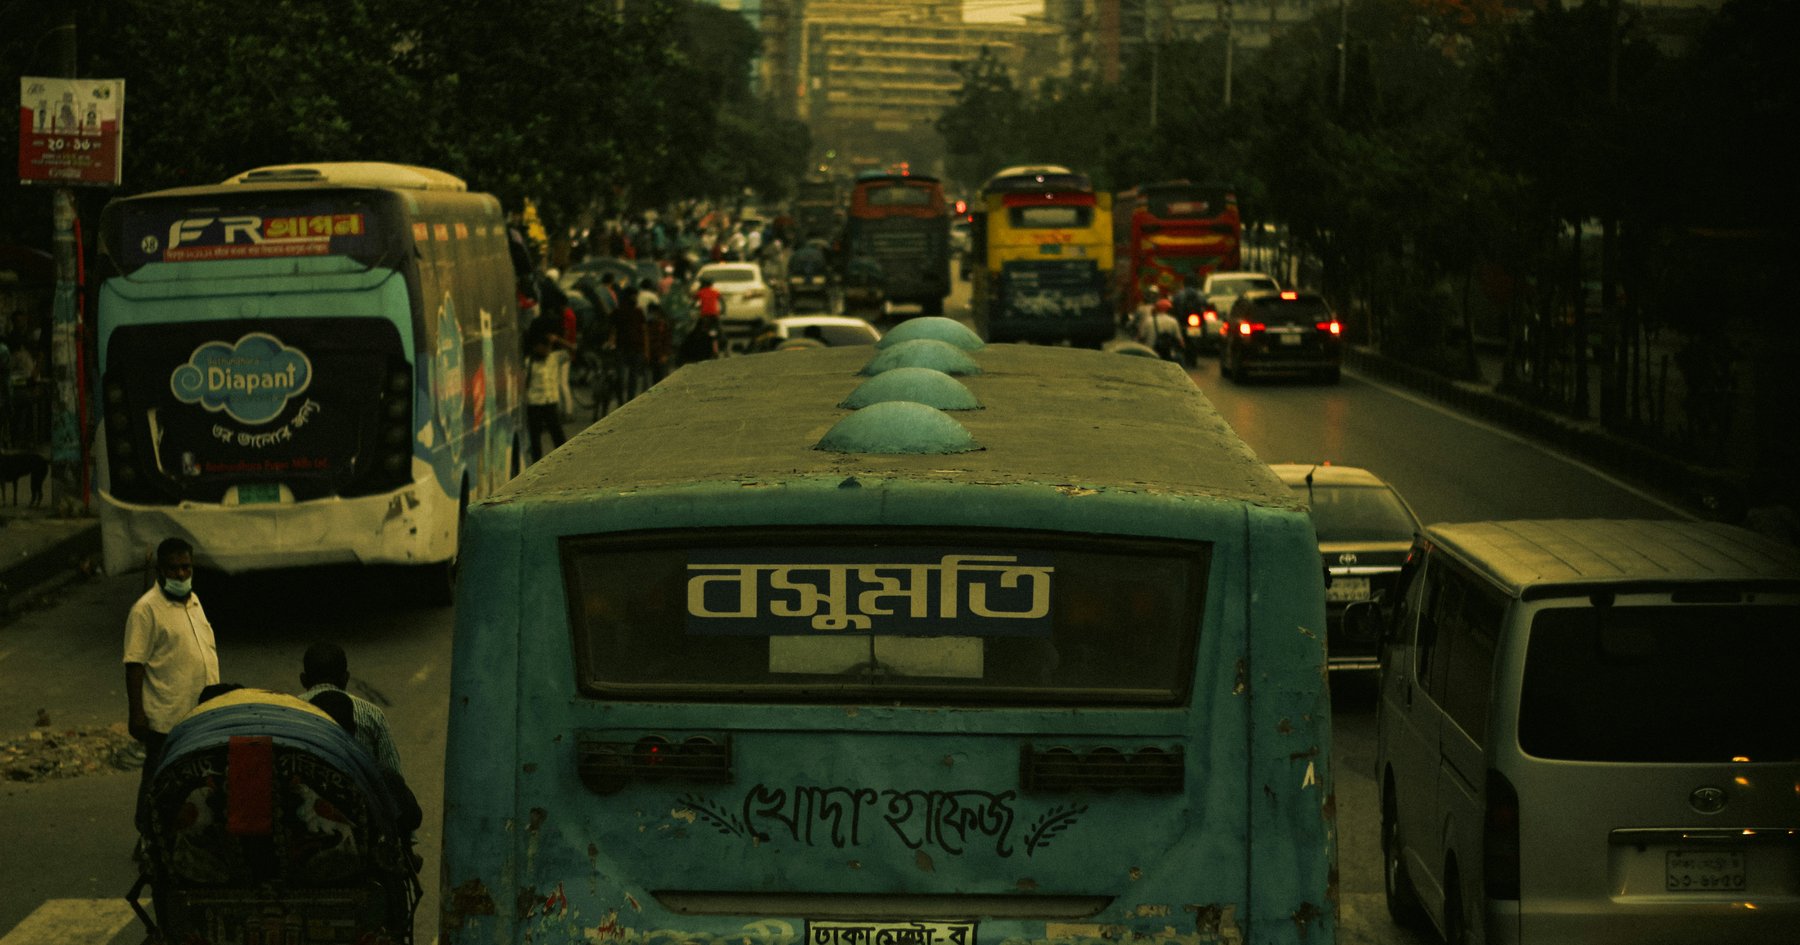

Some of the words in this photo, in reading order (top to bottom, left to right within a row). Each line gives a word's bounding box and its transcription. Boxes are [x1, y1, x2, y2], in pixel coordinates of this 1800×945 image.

[208, 362, 296, 395] Diapant
[687, 554, 1055, 630] বসুমতি
[743, 784, 878, 849] খোদা
[881, 789, 1017, 858] হাফেজ
